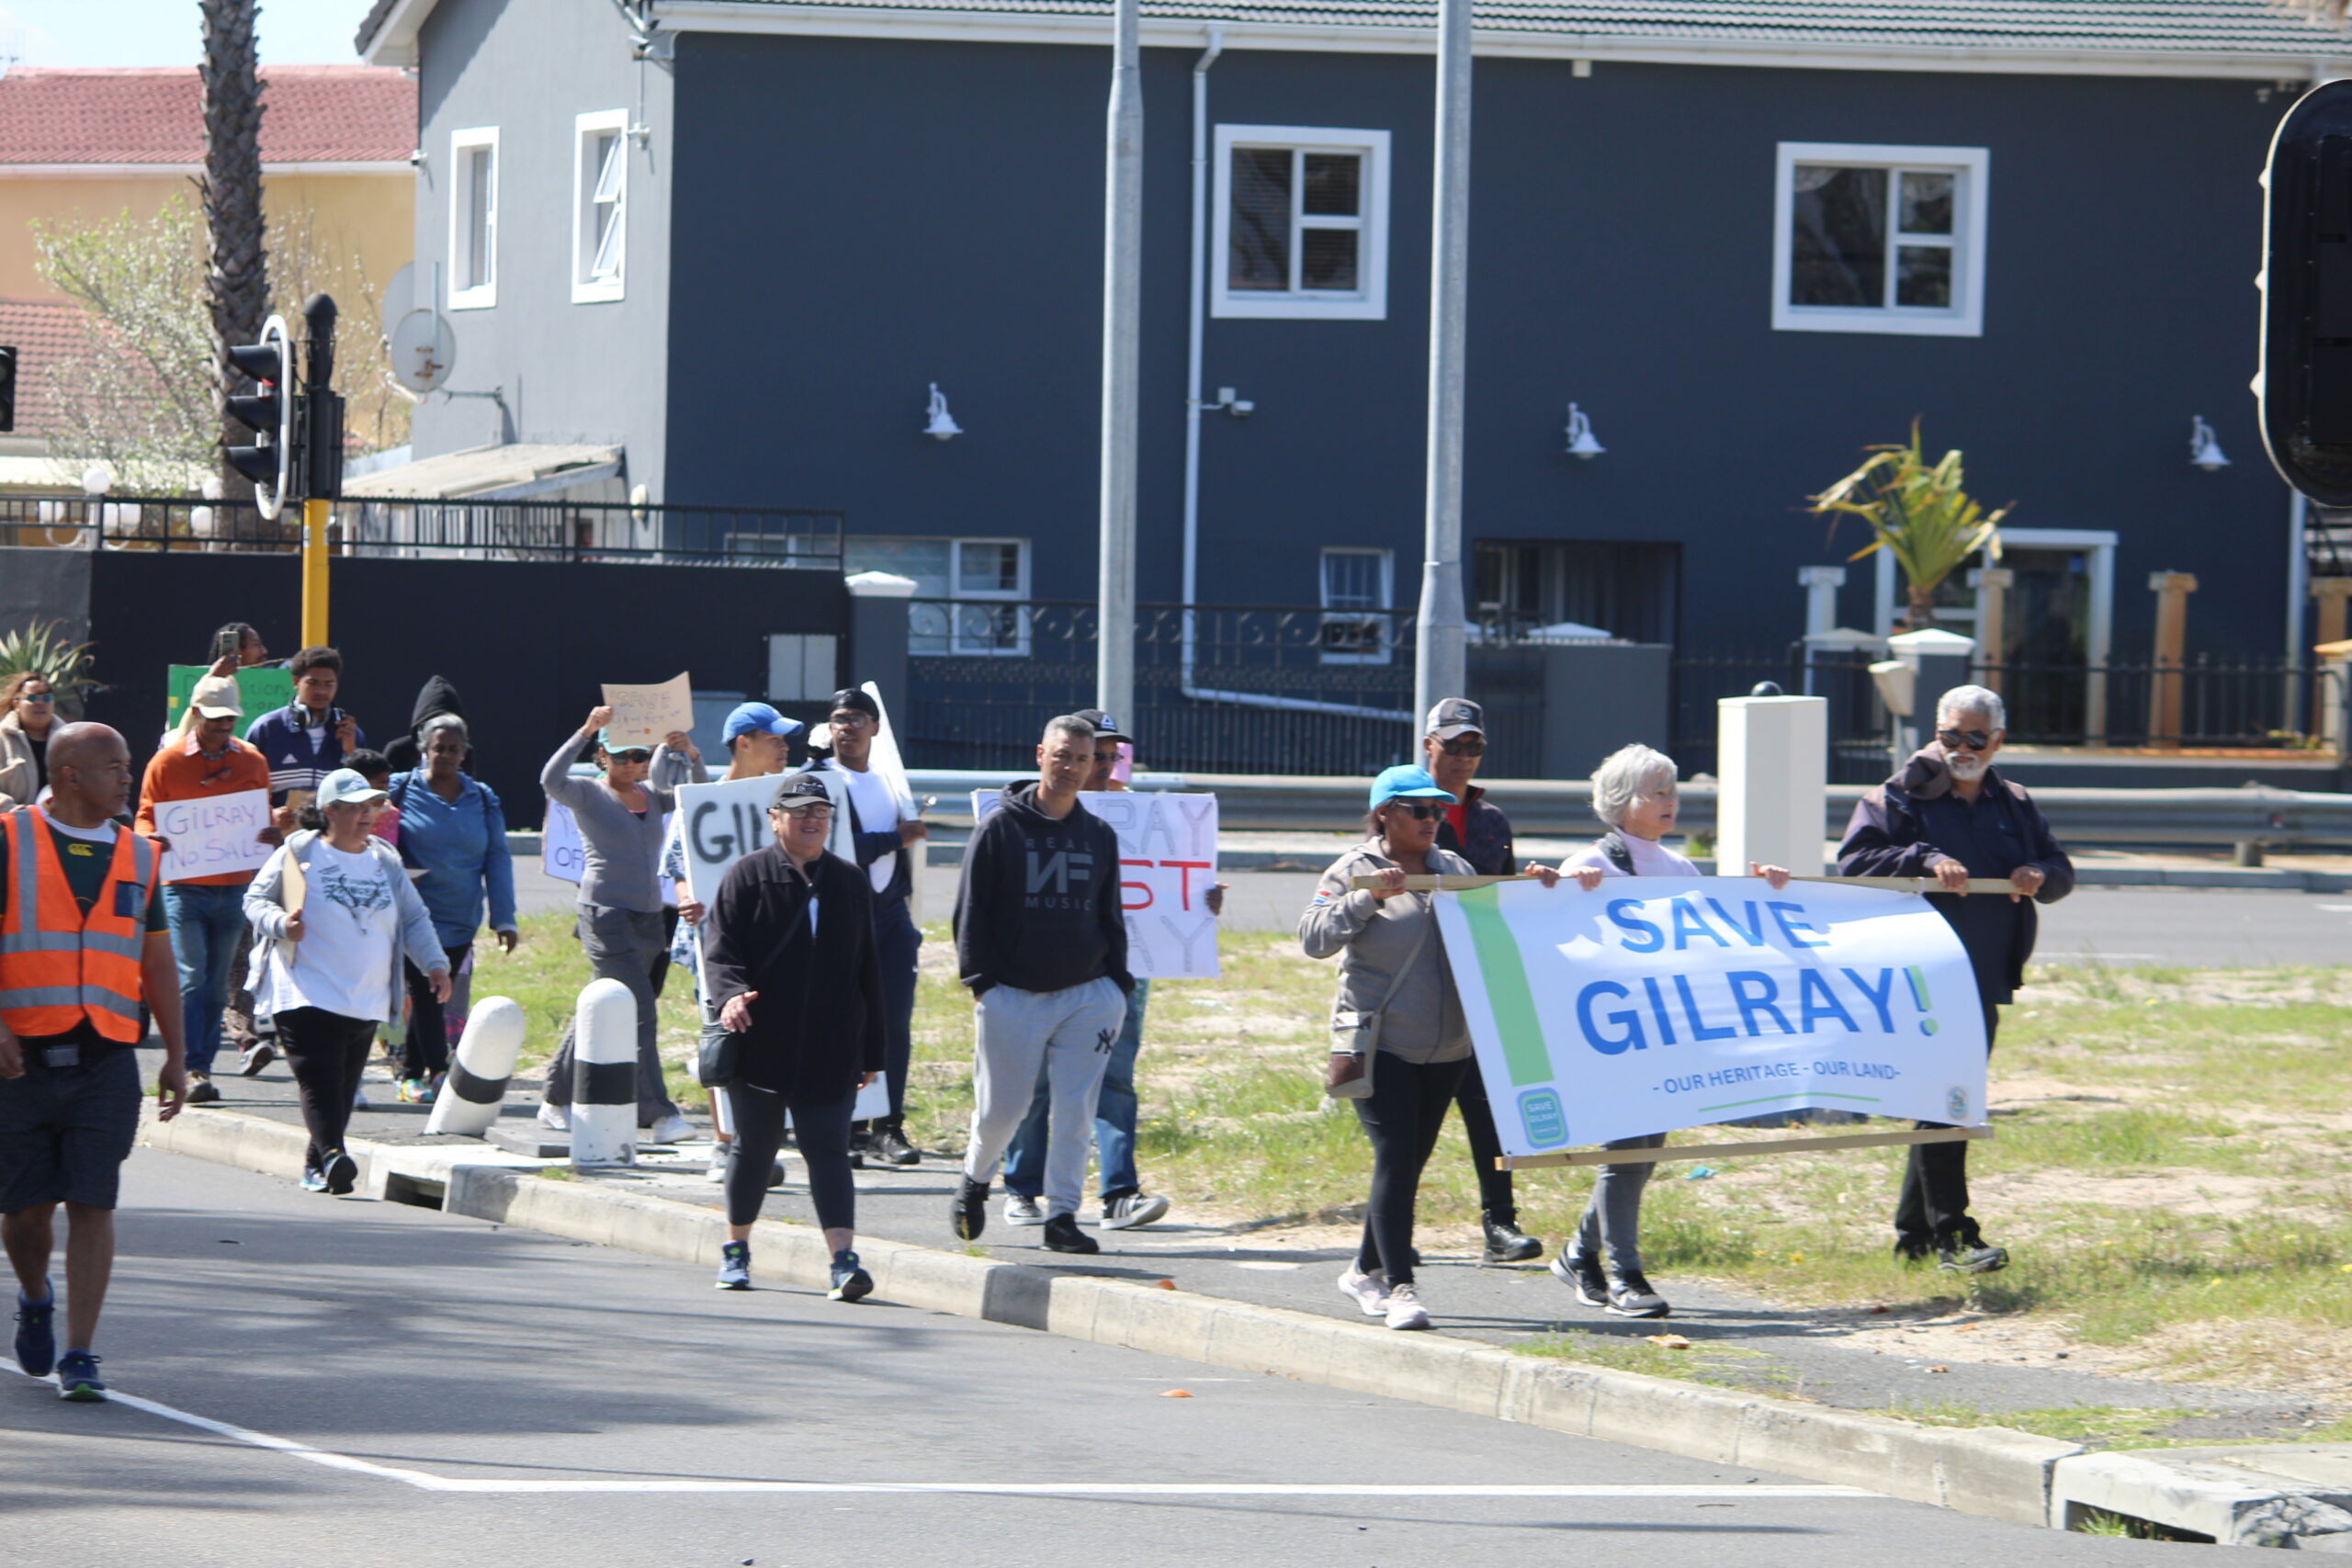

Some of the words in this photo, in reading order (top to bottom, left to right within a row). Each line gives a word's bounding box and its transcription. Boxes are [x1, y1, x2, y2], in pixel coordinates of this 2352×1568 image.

[205, 839, 266, 862] SALE
[1024, 837, 1092, 852] REAL
[555, 846, 584, 872] OF
[1024, 897, 1091, 911] MUSIC
[1606, 897, 1831, 953] SAVE
[1576, 964, 1939, 1055] GILRAY!
[1664, 1074, 1706, 1093] OUR
[1709, 1062, 1798, 1087] HERITAGE
[1813, 1061, 1849, 1076] OUR
